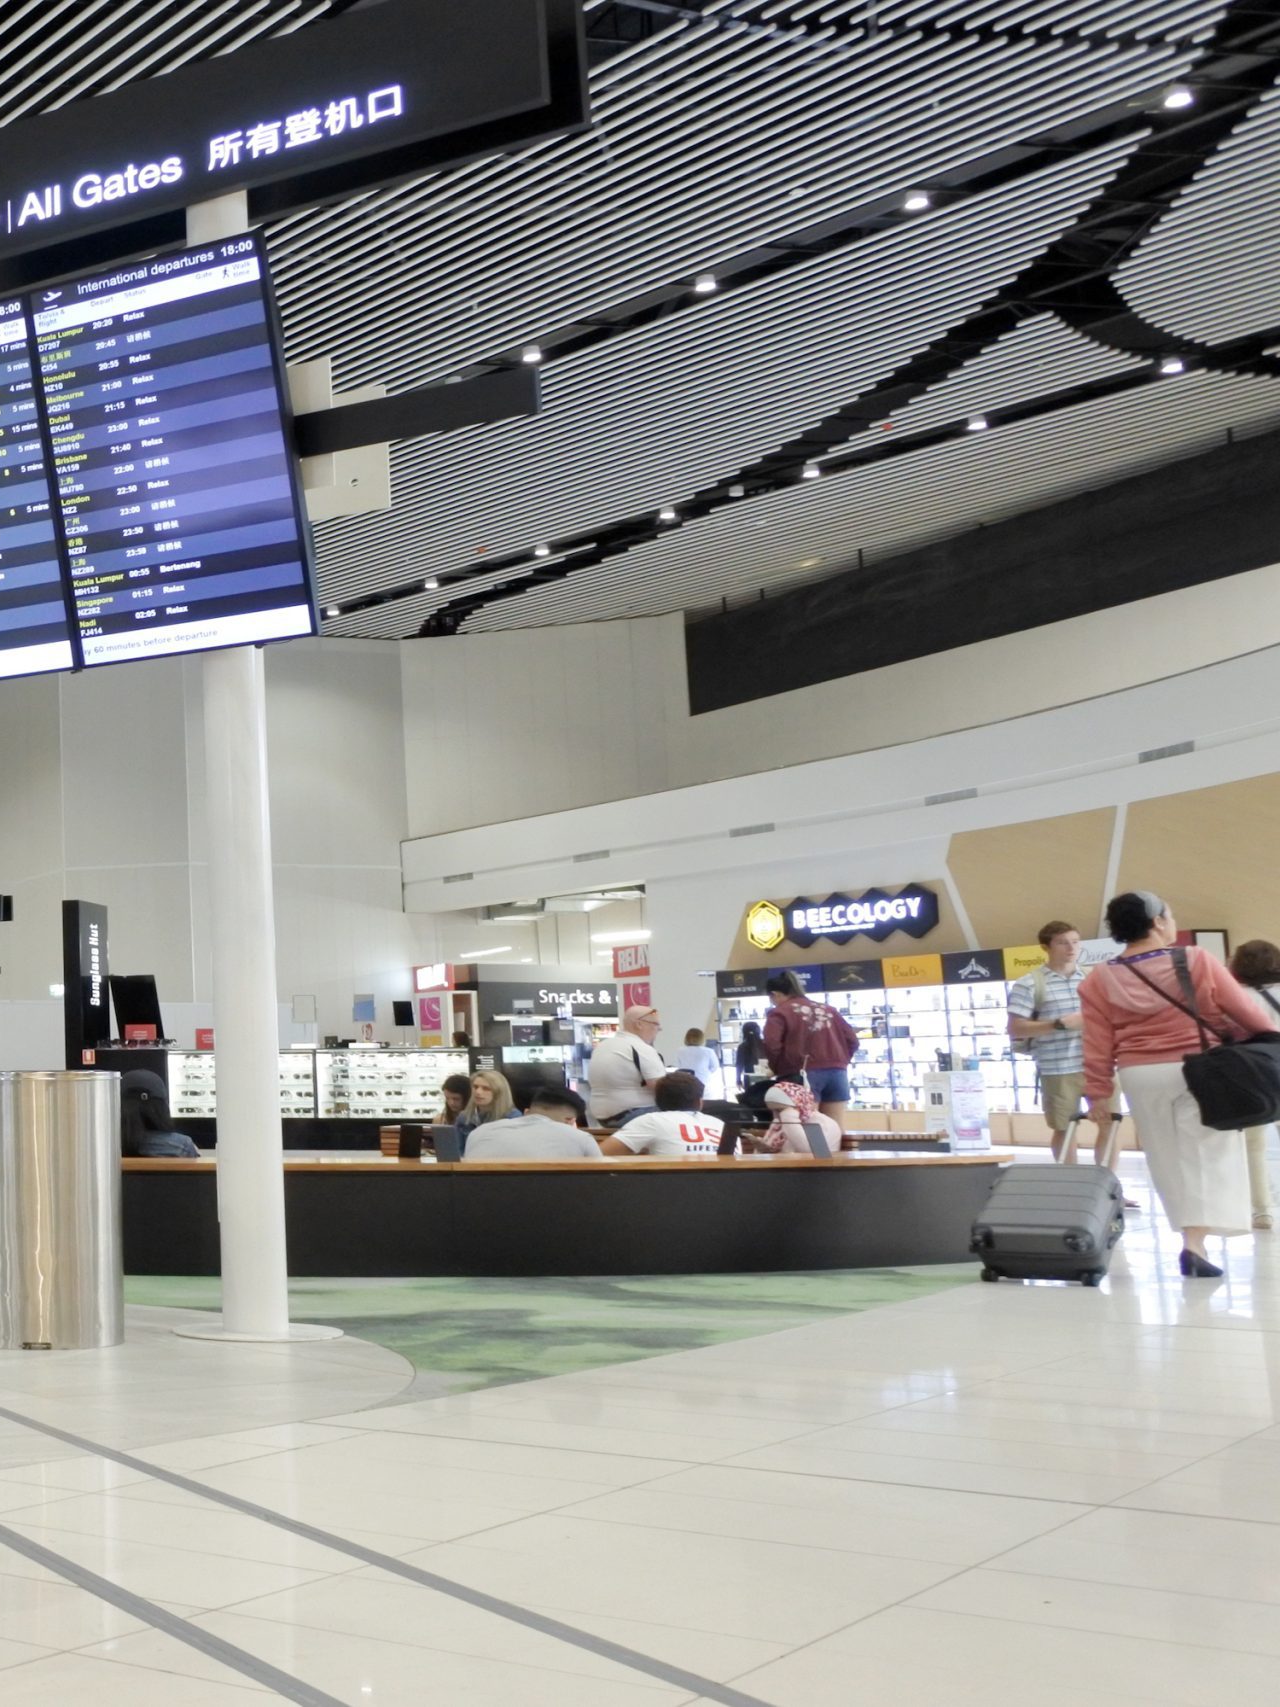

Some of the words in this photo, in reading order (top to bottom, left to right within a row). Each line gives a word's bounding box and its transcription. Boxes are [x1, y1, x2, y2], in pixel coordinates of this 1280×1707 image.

[208, 85, 402, 171] 所有登机口
[18, 185, 61, 226] All
[73, 157, 183, 208] Gates
[77, 266, 147, 294] International
[150, 251, 214, 275] departures
[220, 239, 253, 257] 18:00
[37, 333, 57, 344] Kuala
[57, 326, 84, 338] Lumpur
[123, 311, 144, 322] Relax
[10, 342, 26, 351] mins
[13, 362, 29, 371] mins
[43, 371, 75, 385] Honolulu
[129, 354, 150, 364] Relax
[15, 382, 31, 391] mins
[46, 391, 84, 405] Melbourne
[132, 375, 153, 385] Relax
[18, 403, 35, 412] mins
[49, 414, 70, 425] Dubai
[135, 396, 156, 406] Relax
[21, 423, 37, 432] mins
[52, 433, 84, 446] Chengdu
[138, 417, 160, 427] Relax
[55, 454, 87, 466] Brisbane
[141, 438, 163, 448] Relax
[27, 464, 43, 472] mins
[61, 496, 90, 507] London
[147, 480, 169, 490] Relax
[32, 504, 48, 513] mins
[73, 578, 94, 588] Kuala
[95, 574, 123, 584] Lumpur
[76, 596, 113, 608] Singapore
[162, 585, 184, 594] Relax
[79, 619, 96, 628] Nadi
[166, 606, 187, 615] Relax
[93, 645, 103, 653] 60
[106, 641, 141, 652] minutes
[143, 637, 171, 646] before
[174, 629, 218, 641] departure
[792, 896, 921, 929] BEECOLOGY
[89, 923, 98, 945] Hut
[90, 948, 101, 1006] Sunglass
[539, 989, 594, 1004] Snacks
[599, 990, 611, 1004] &
